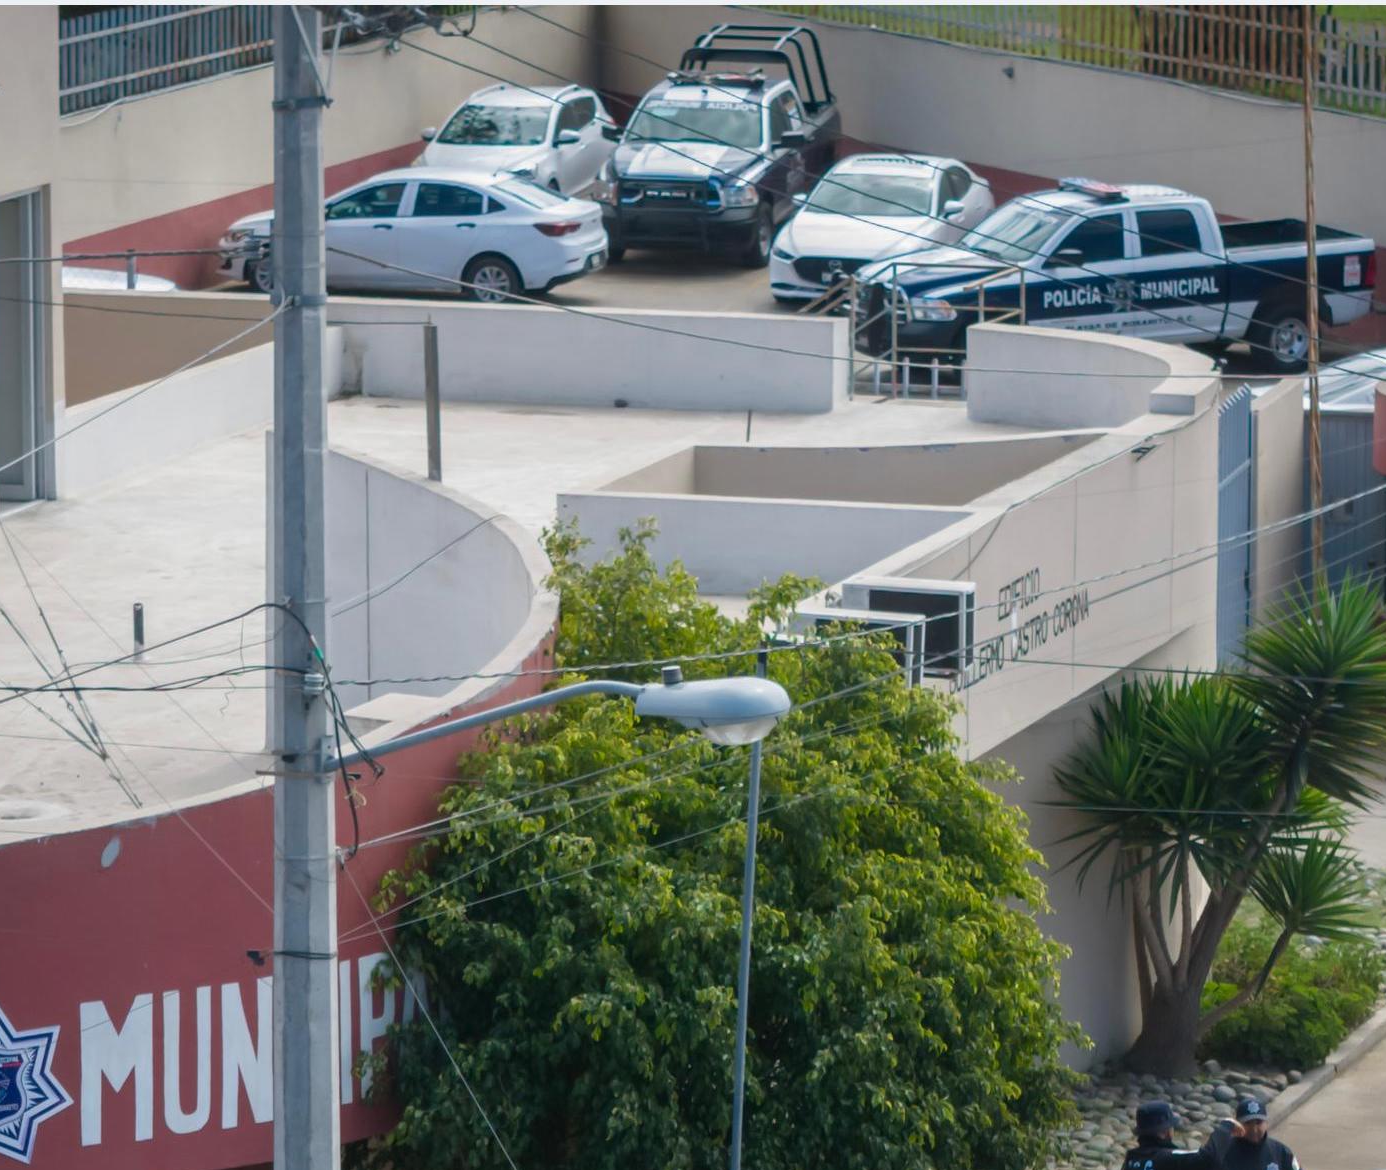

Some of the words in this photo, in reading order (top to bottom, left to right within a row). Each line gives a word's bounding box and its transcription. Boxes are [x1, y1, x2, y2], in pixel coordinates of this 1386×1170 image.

[1140, 276, 1220, 300] MUNICIPAL
[998, 567, 1041, 622] EDIFICIO
[1053, 588, 1090, 637] CORONA
[80, 952, 435, 1147] MUNIPA
